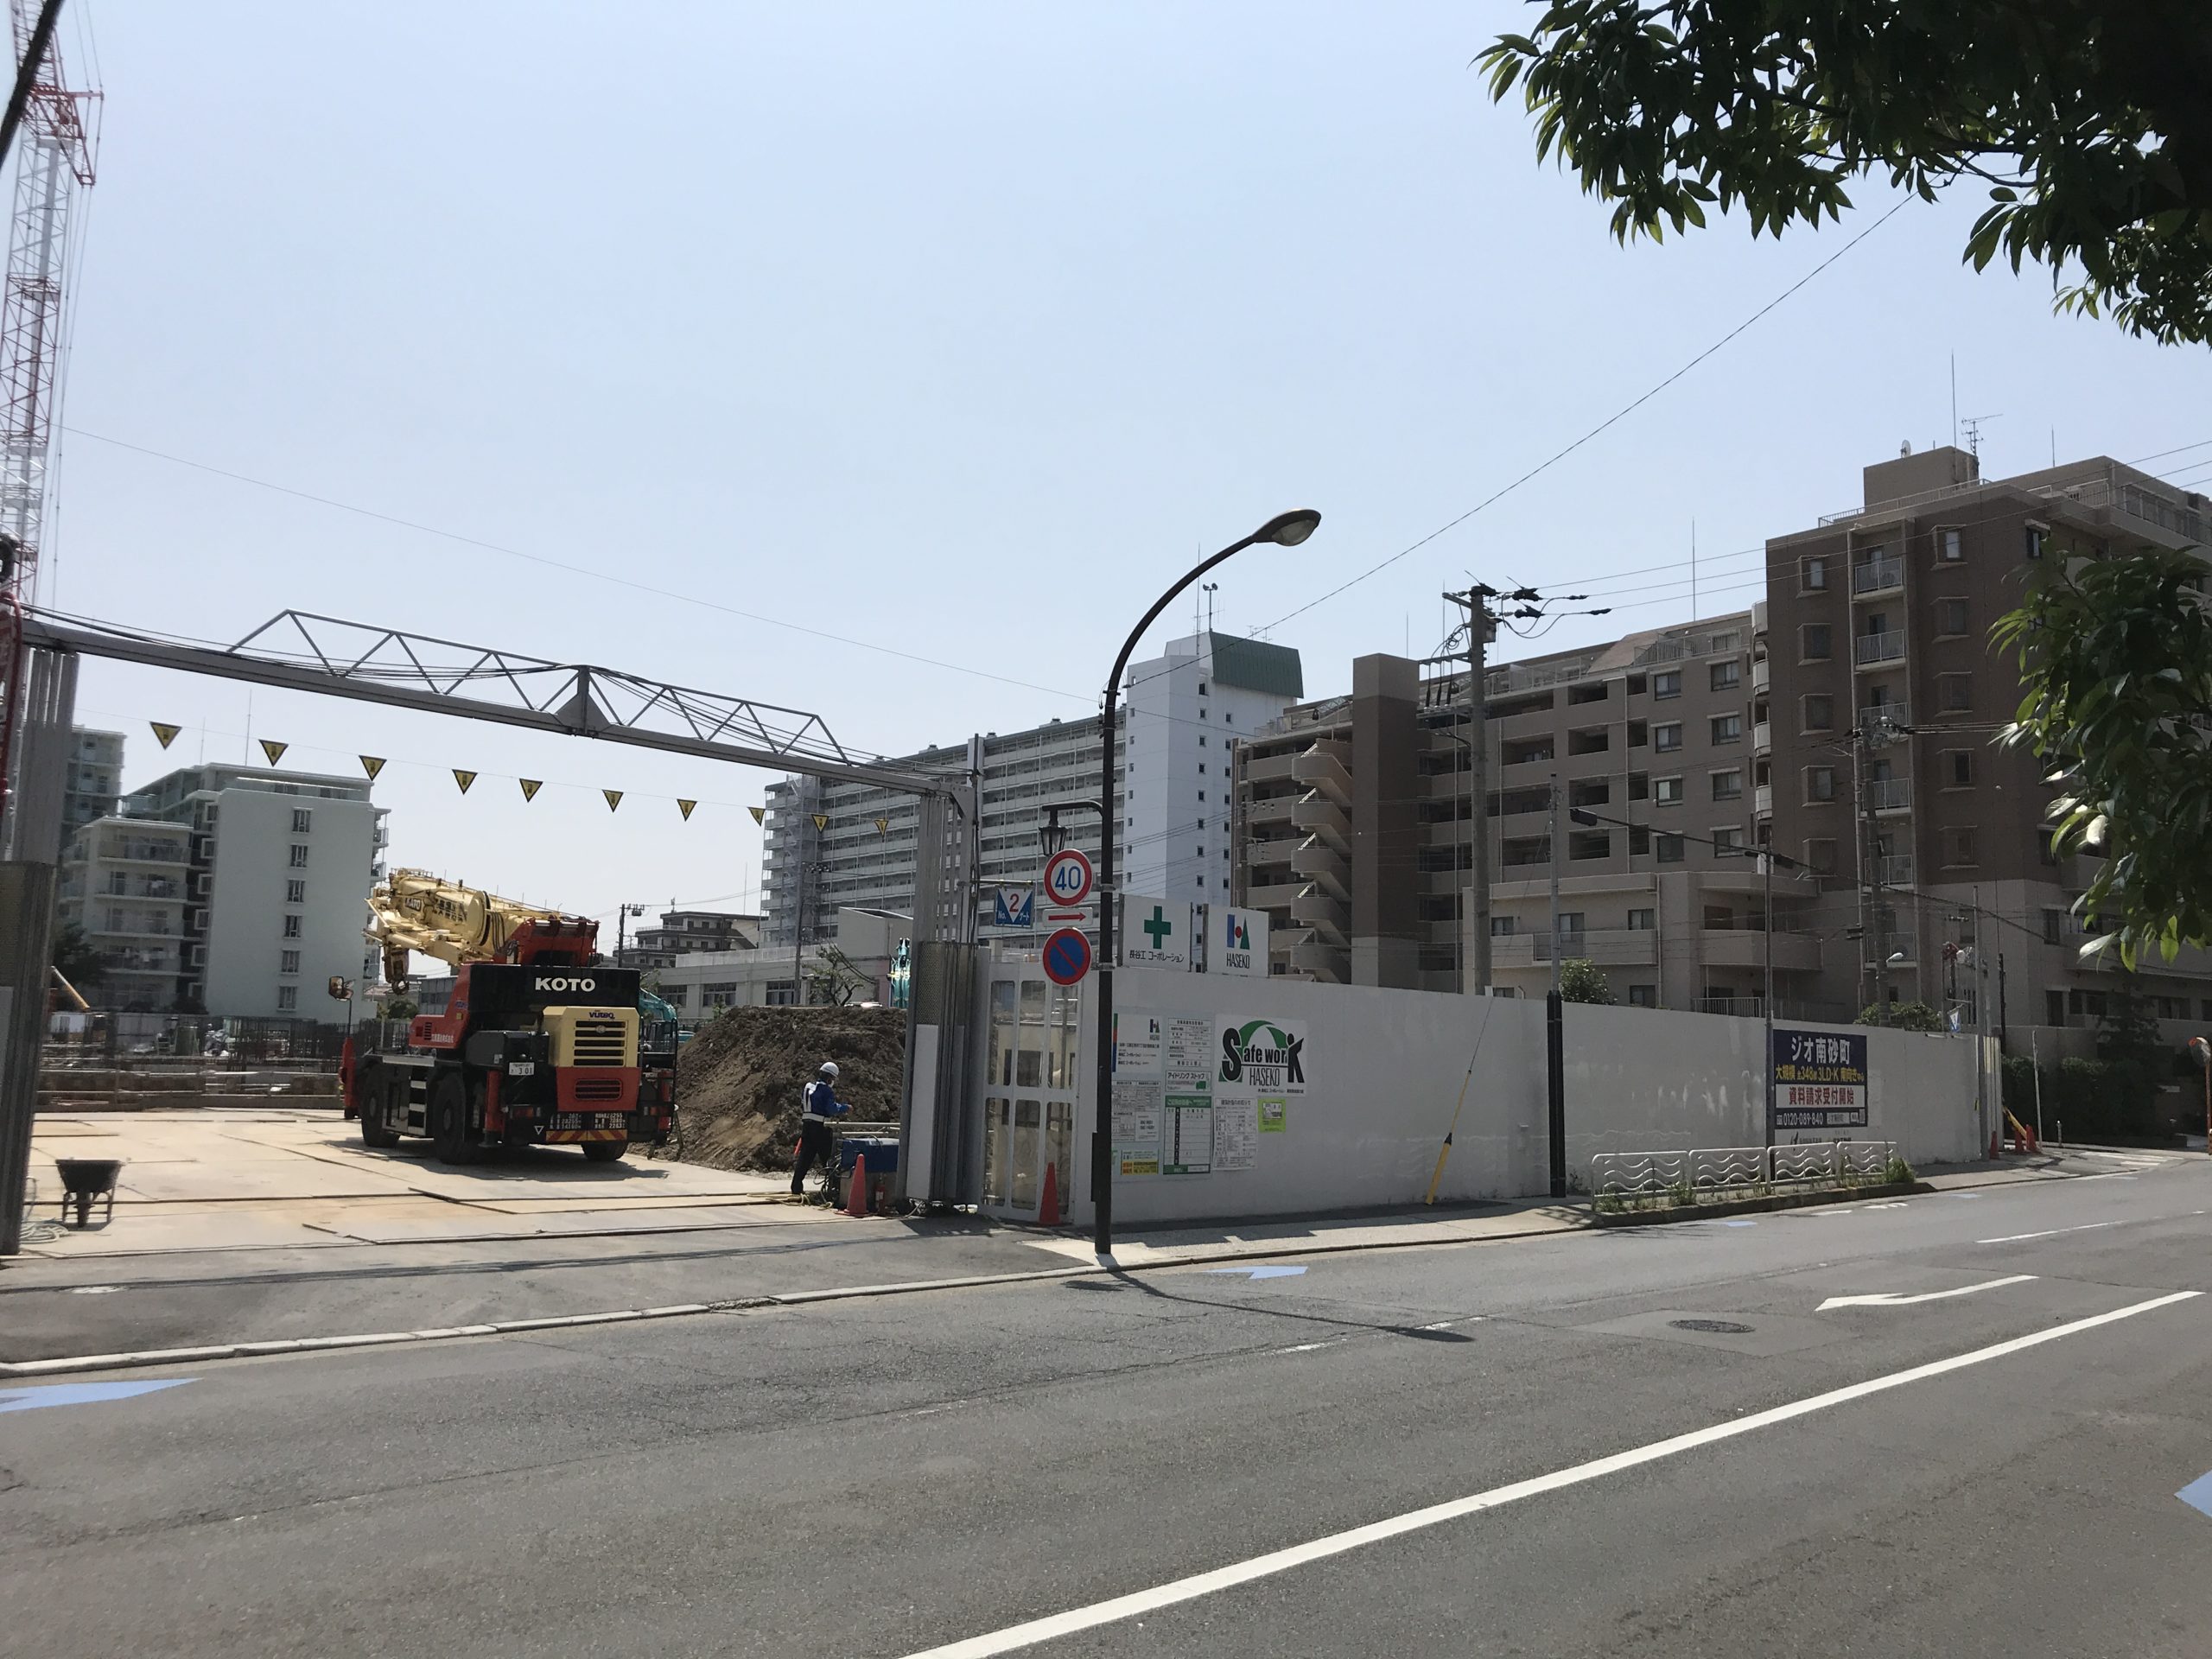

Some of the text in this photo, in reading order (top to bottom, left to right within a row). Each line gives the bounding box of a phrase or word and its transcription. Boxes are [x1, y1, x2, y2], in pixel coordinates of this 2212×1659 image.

[1055, 866, 1081, 891] 40
[1009, 893, 1020, 912] 2
[1226, 953, 1250, 969] HASEKO
[535, 977, 596, 993] KOTO
[1791, 1035, 1851, 1065] ジオ南砂町
[1249, 1067, 1280, 1086] HASEKO
